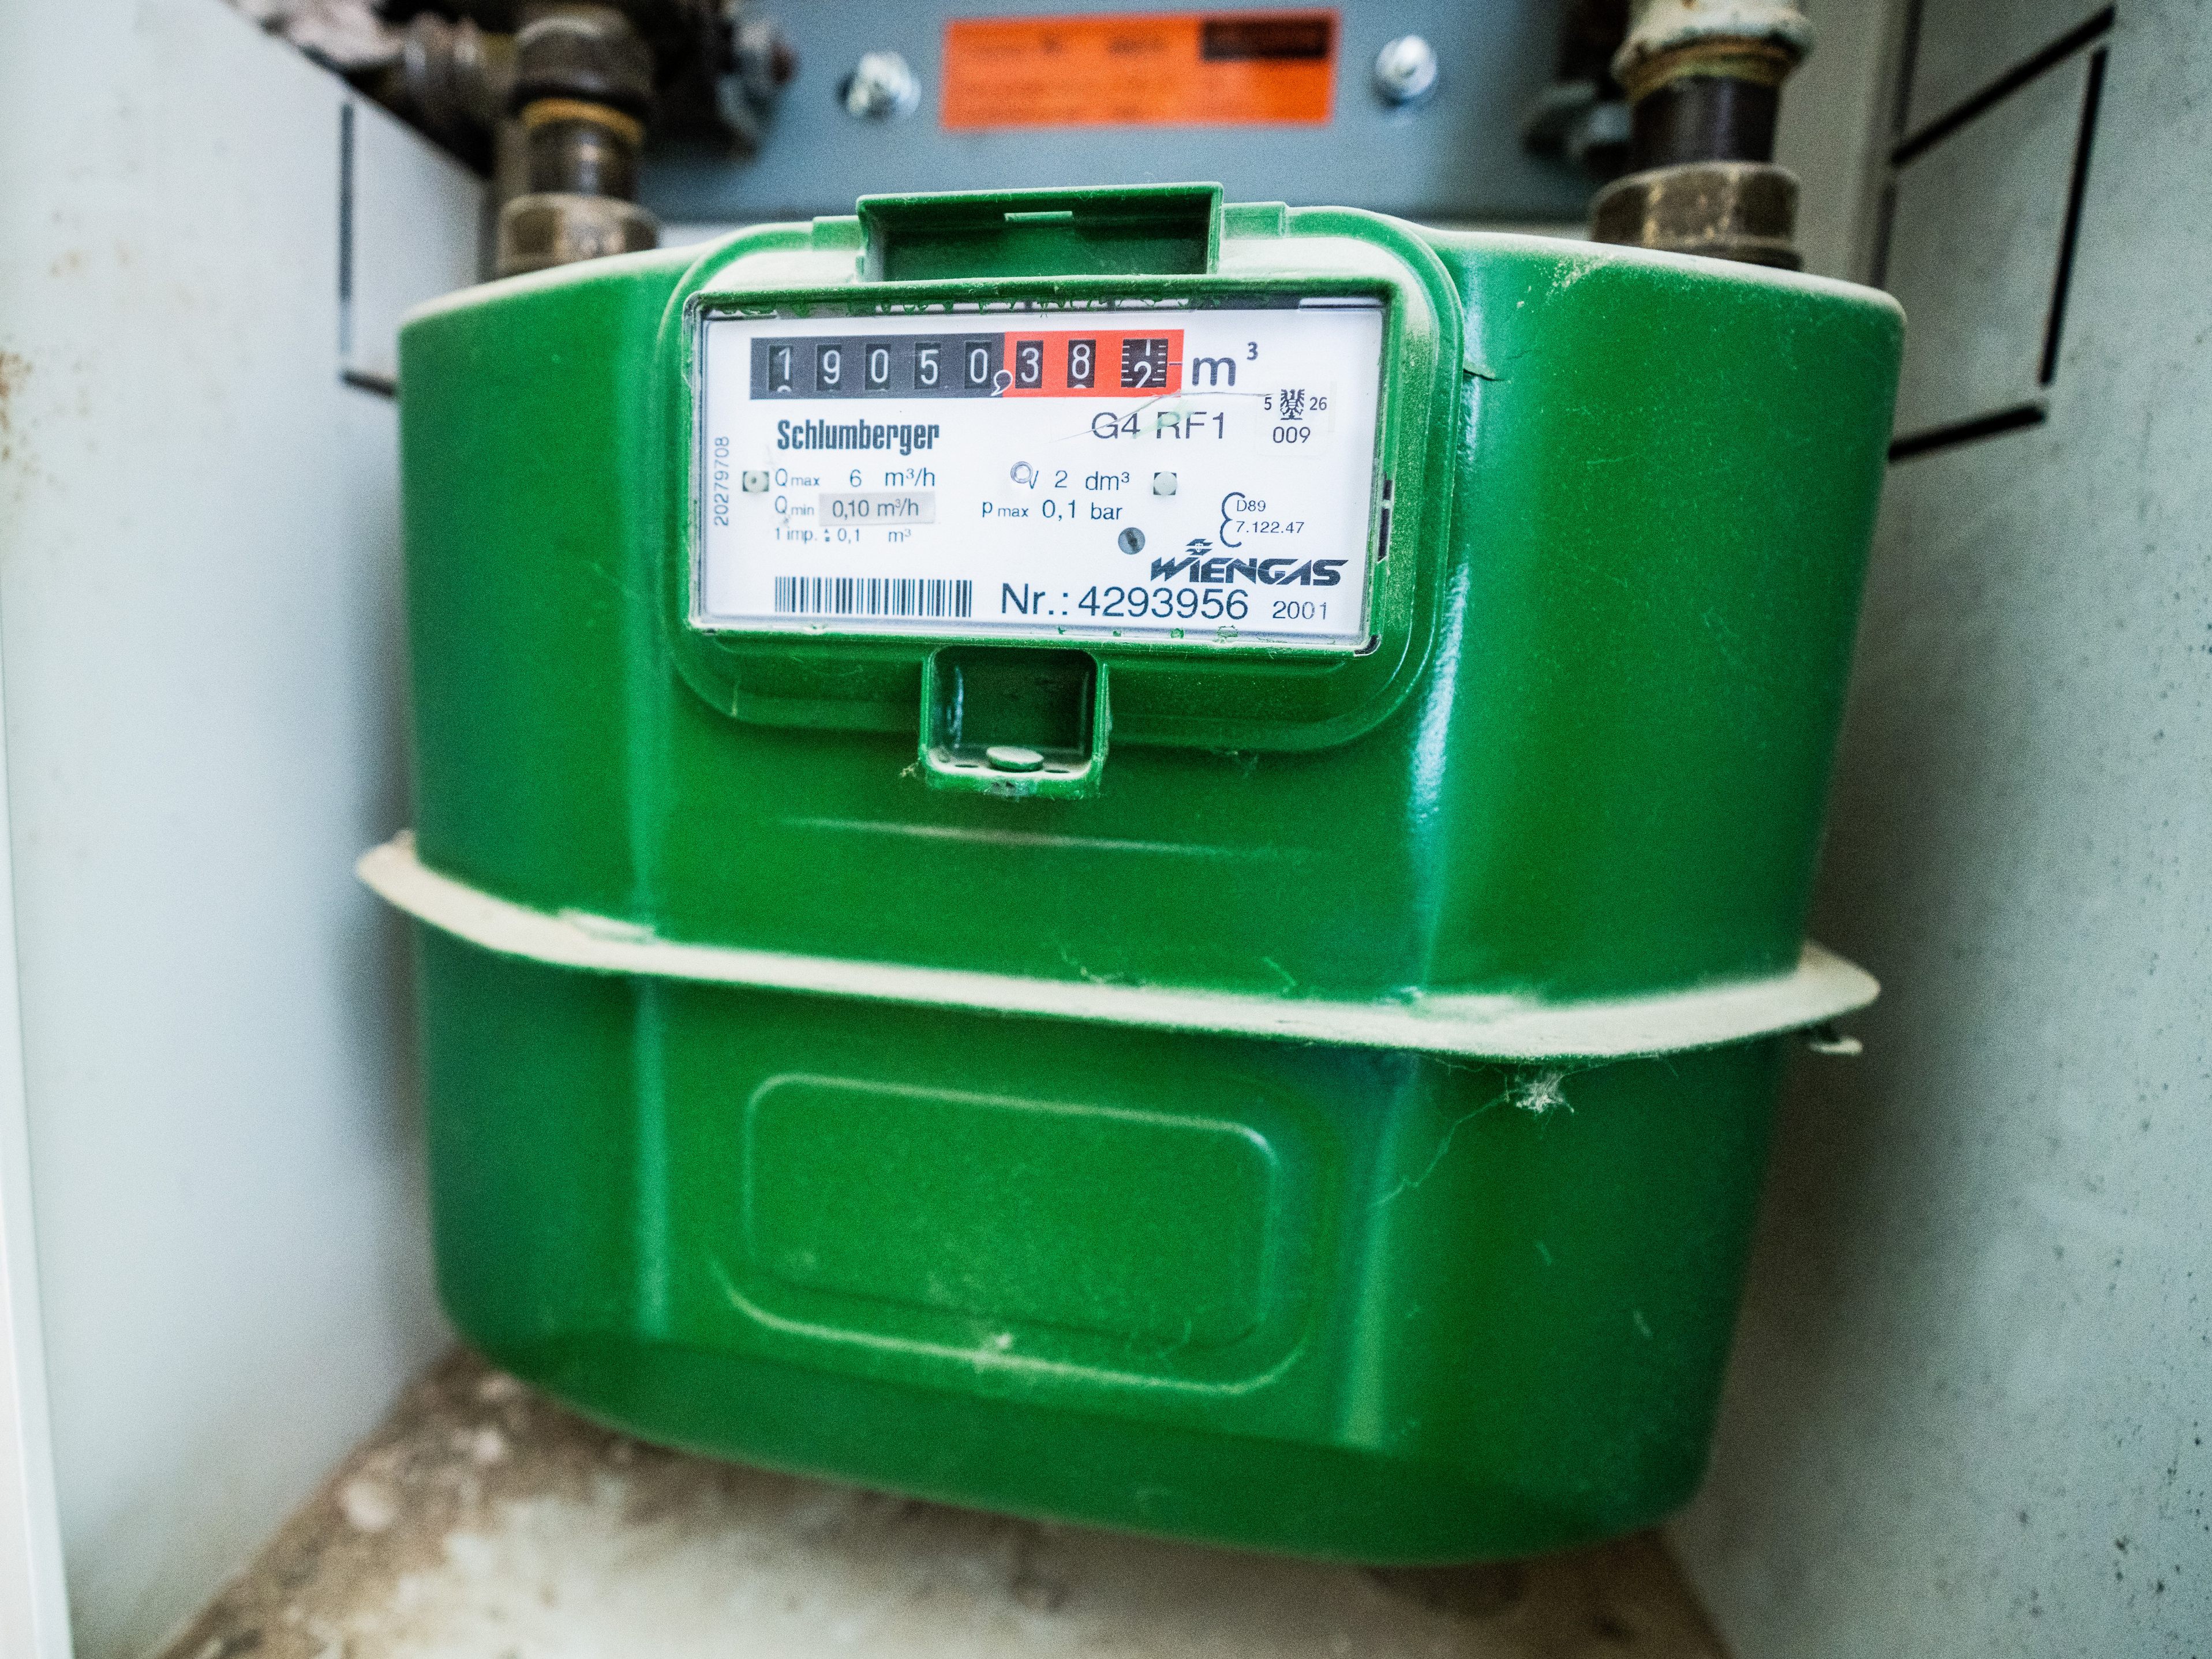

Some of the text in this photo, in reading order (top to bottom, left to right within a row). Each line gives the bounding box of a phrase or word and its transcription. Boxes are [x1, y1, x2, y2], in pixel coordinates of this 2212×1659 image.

[1264, 396, 1327, 411] 5 26
[1091, 411, 1225, 440] G4 RF1
[1272, 426, 1311, 444] 009
[777, 419, 940, 456] Schlumberger
[713, 436, 729, 526] 20279708
[849, 469, 862, 488] 6
[1054, 470, 1068, 488] 2
[832, 500, 870, 520] 0,10
[1042, 499, 1076, 521] 0,1
[1091, 502, 1123, 520] bar
[1236, 500, 1266, 512] D89
[776, 527, 781, 541] 1
[787, 527, 818, 544] imp.
[837, 527, 860, 544] 0,1
[1236, 521, 1305, 534] 7.122.47
[1150, 556, 1349, 586] WIENGAS
[1001, 582, 1327, 620] Nr.: 4293956 2001
